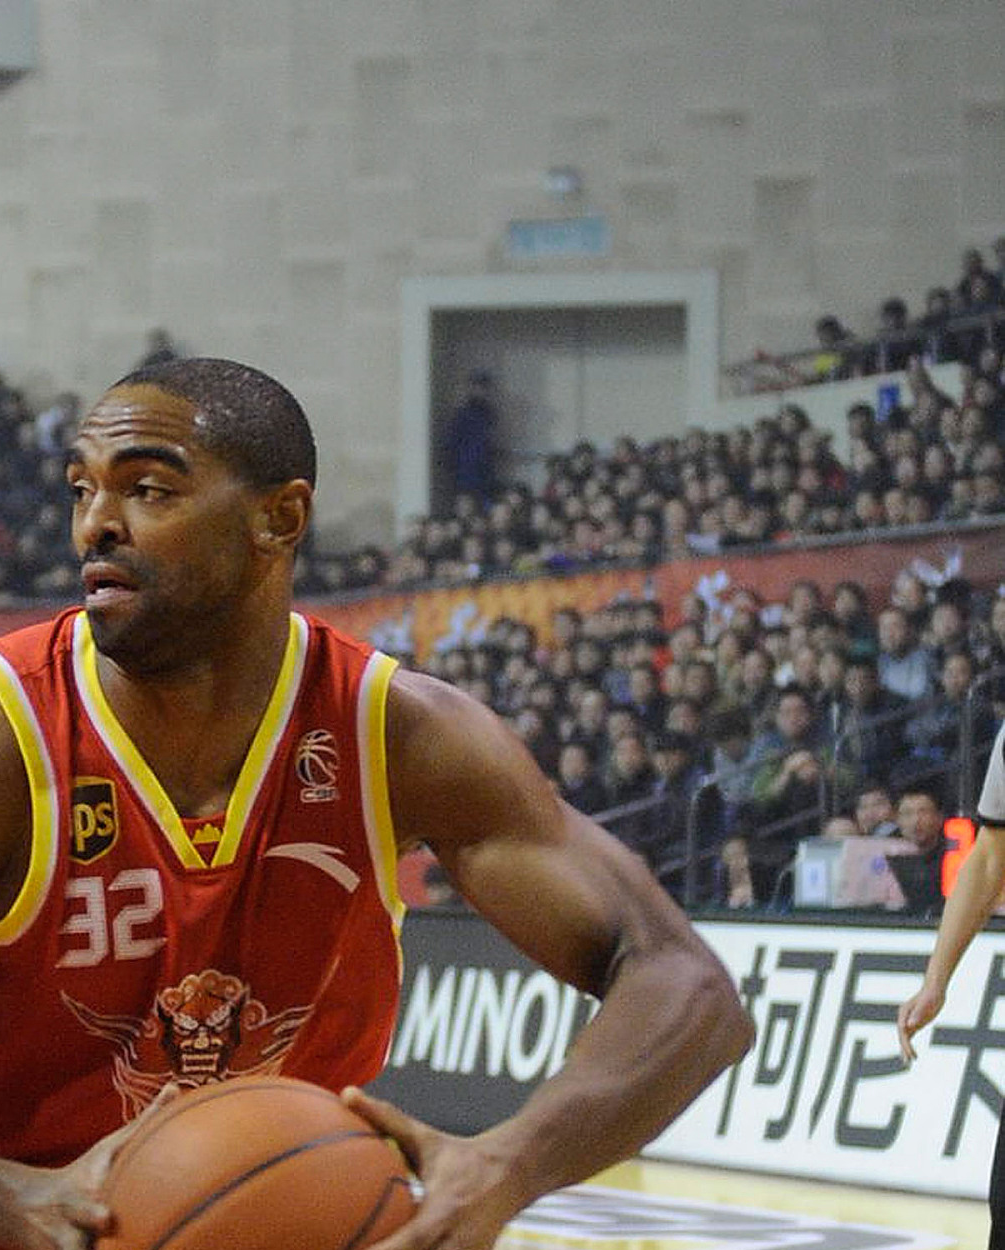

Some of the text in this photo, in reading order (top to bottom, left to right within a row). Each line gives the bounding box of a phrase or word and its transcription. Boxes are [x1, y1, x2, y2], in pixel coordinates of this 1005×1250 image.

[74, 803, 114, 852] ps
[55, 868, 168, 968] 32
[392, 964, 602, 1082] MINOL
